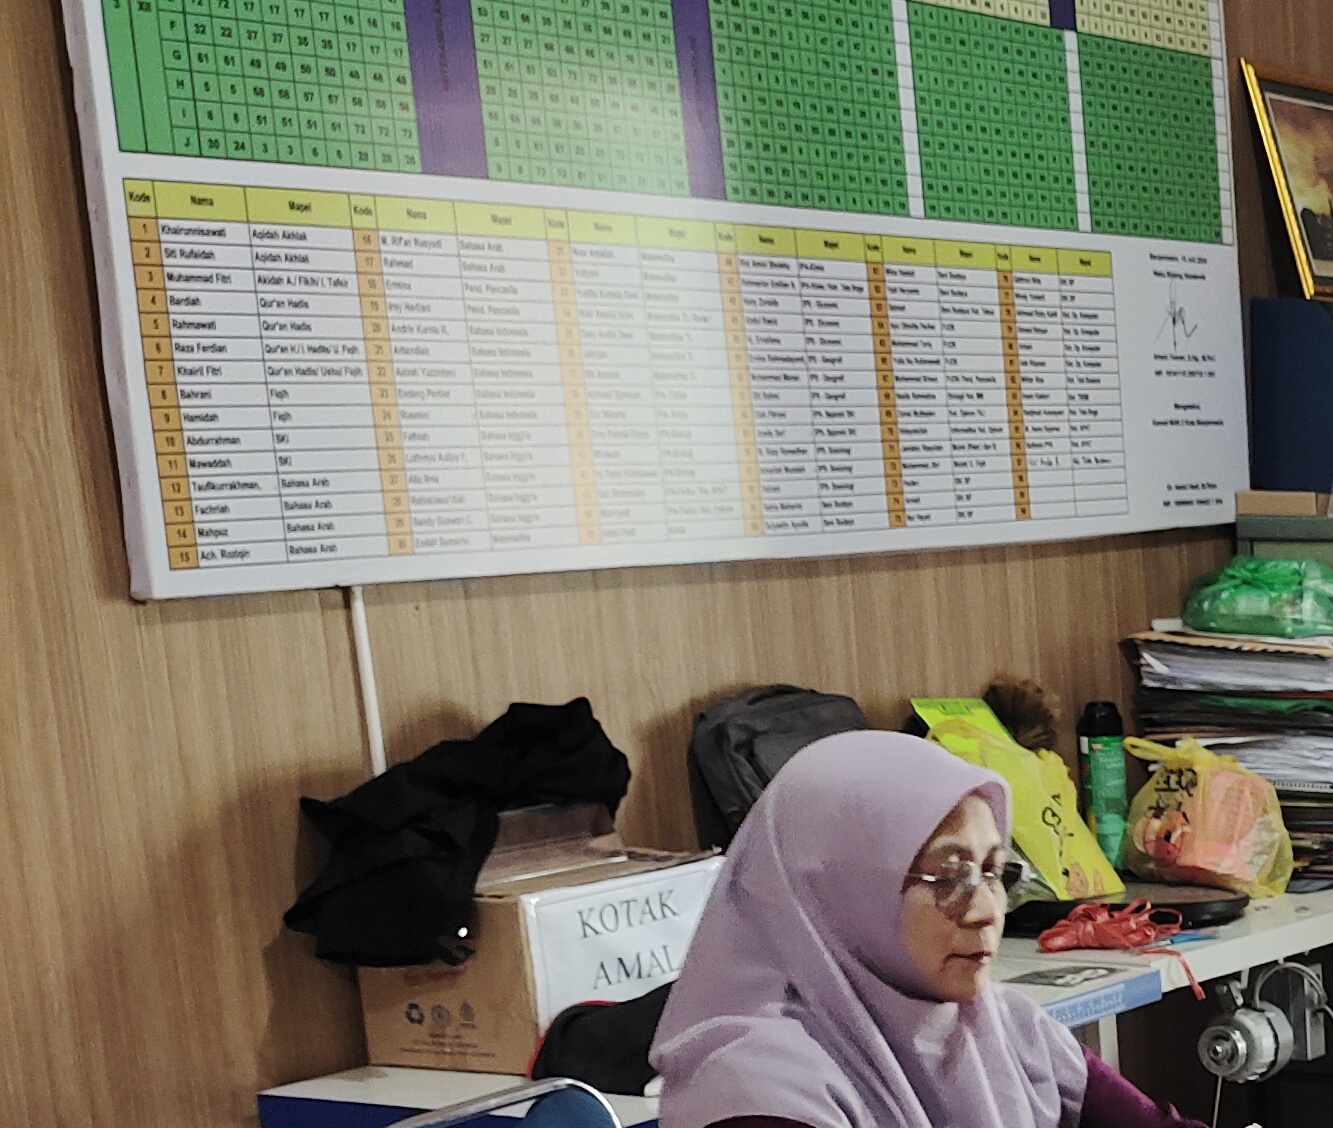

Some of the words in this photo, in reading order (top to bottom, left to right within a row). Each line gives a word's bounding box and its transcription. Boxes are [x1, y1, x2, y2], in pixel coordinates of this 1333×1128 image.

[269, 5, 280, 15] 17
[294, 8, 305, 18] 17
[319, 12, 330, 22] 17
[190, 196, 214, 207] Nama
[577, 889, 679, 939] KOTAK
[592, 945, 681, 991] AMAL
